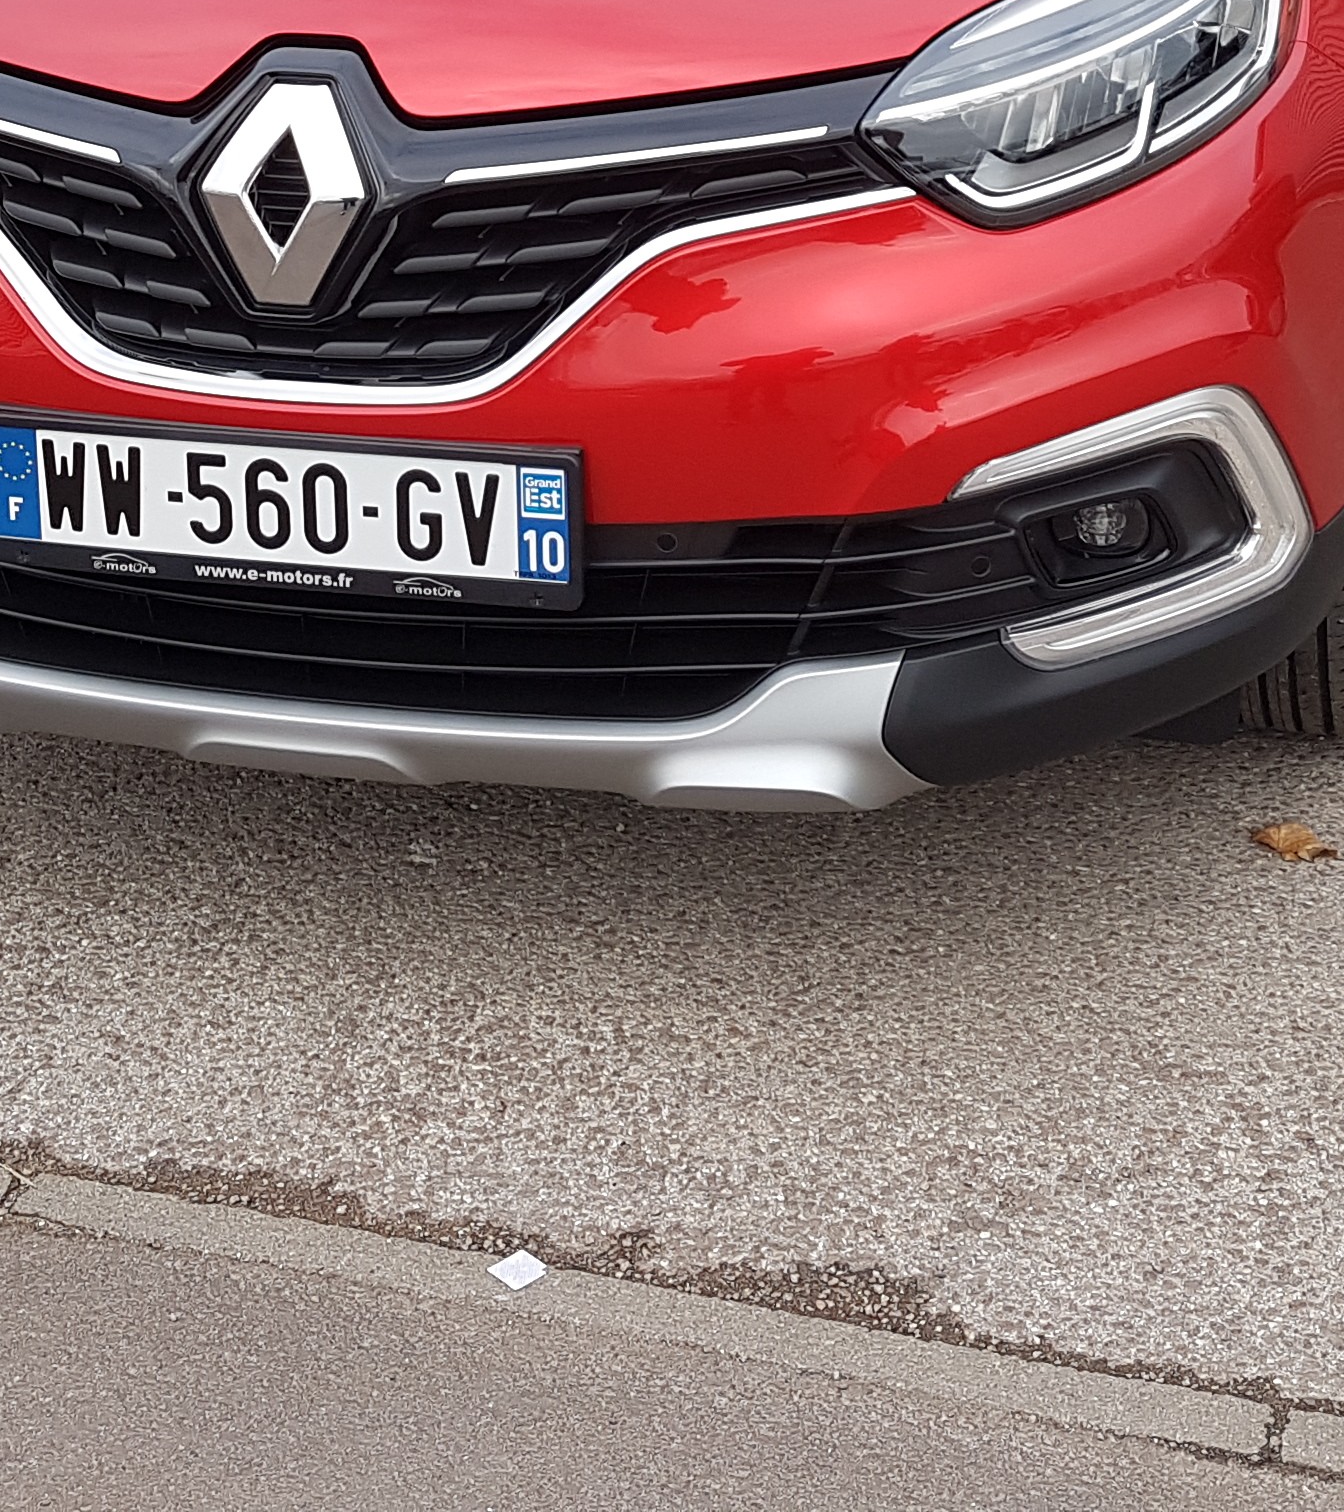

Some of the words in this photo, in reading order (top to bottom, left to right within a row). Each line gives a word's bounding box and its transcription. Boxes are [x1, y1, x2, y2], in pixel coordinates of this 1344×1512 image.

[525, 476, 561, 489] Grand
[9, 496, 23, 521] F
[525, 488, 561, 509] Est
[523, 529, 565, 573] 10
[194, 564, 354, 588] www.e-motors.fr
